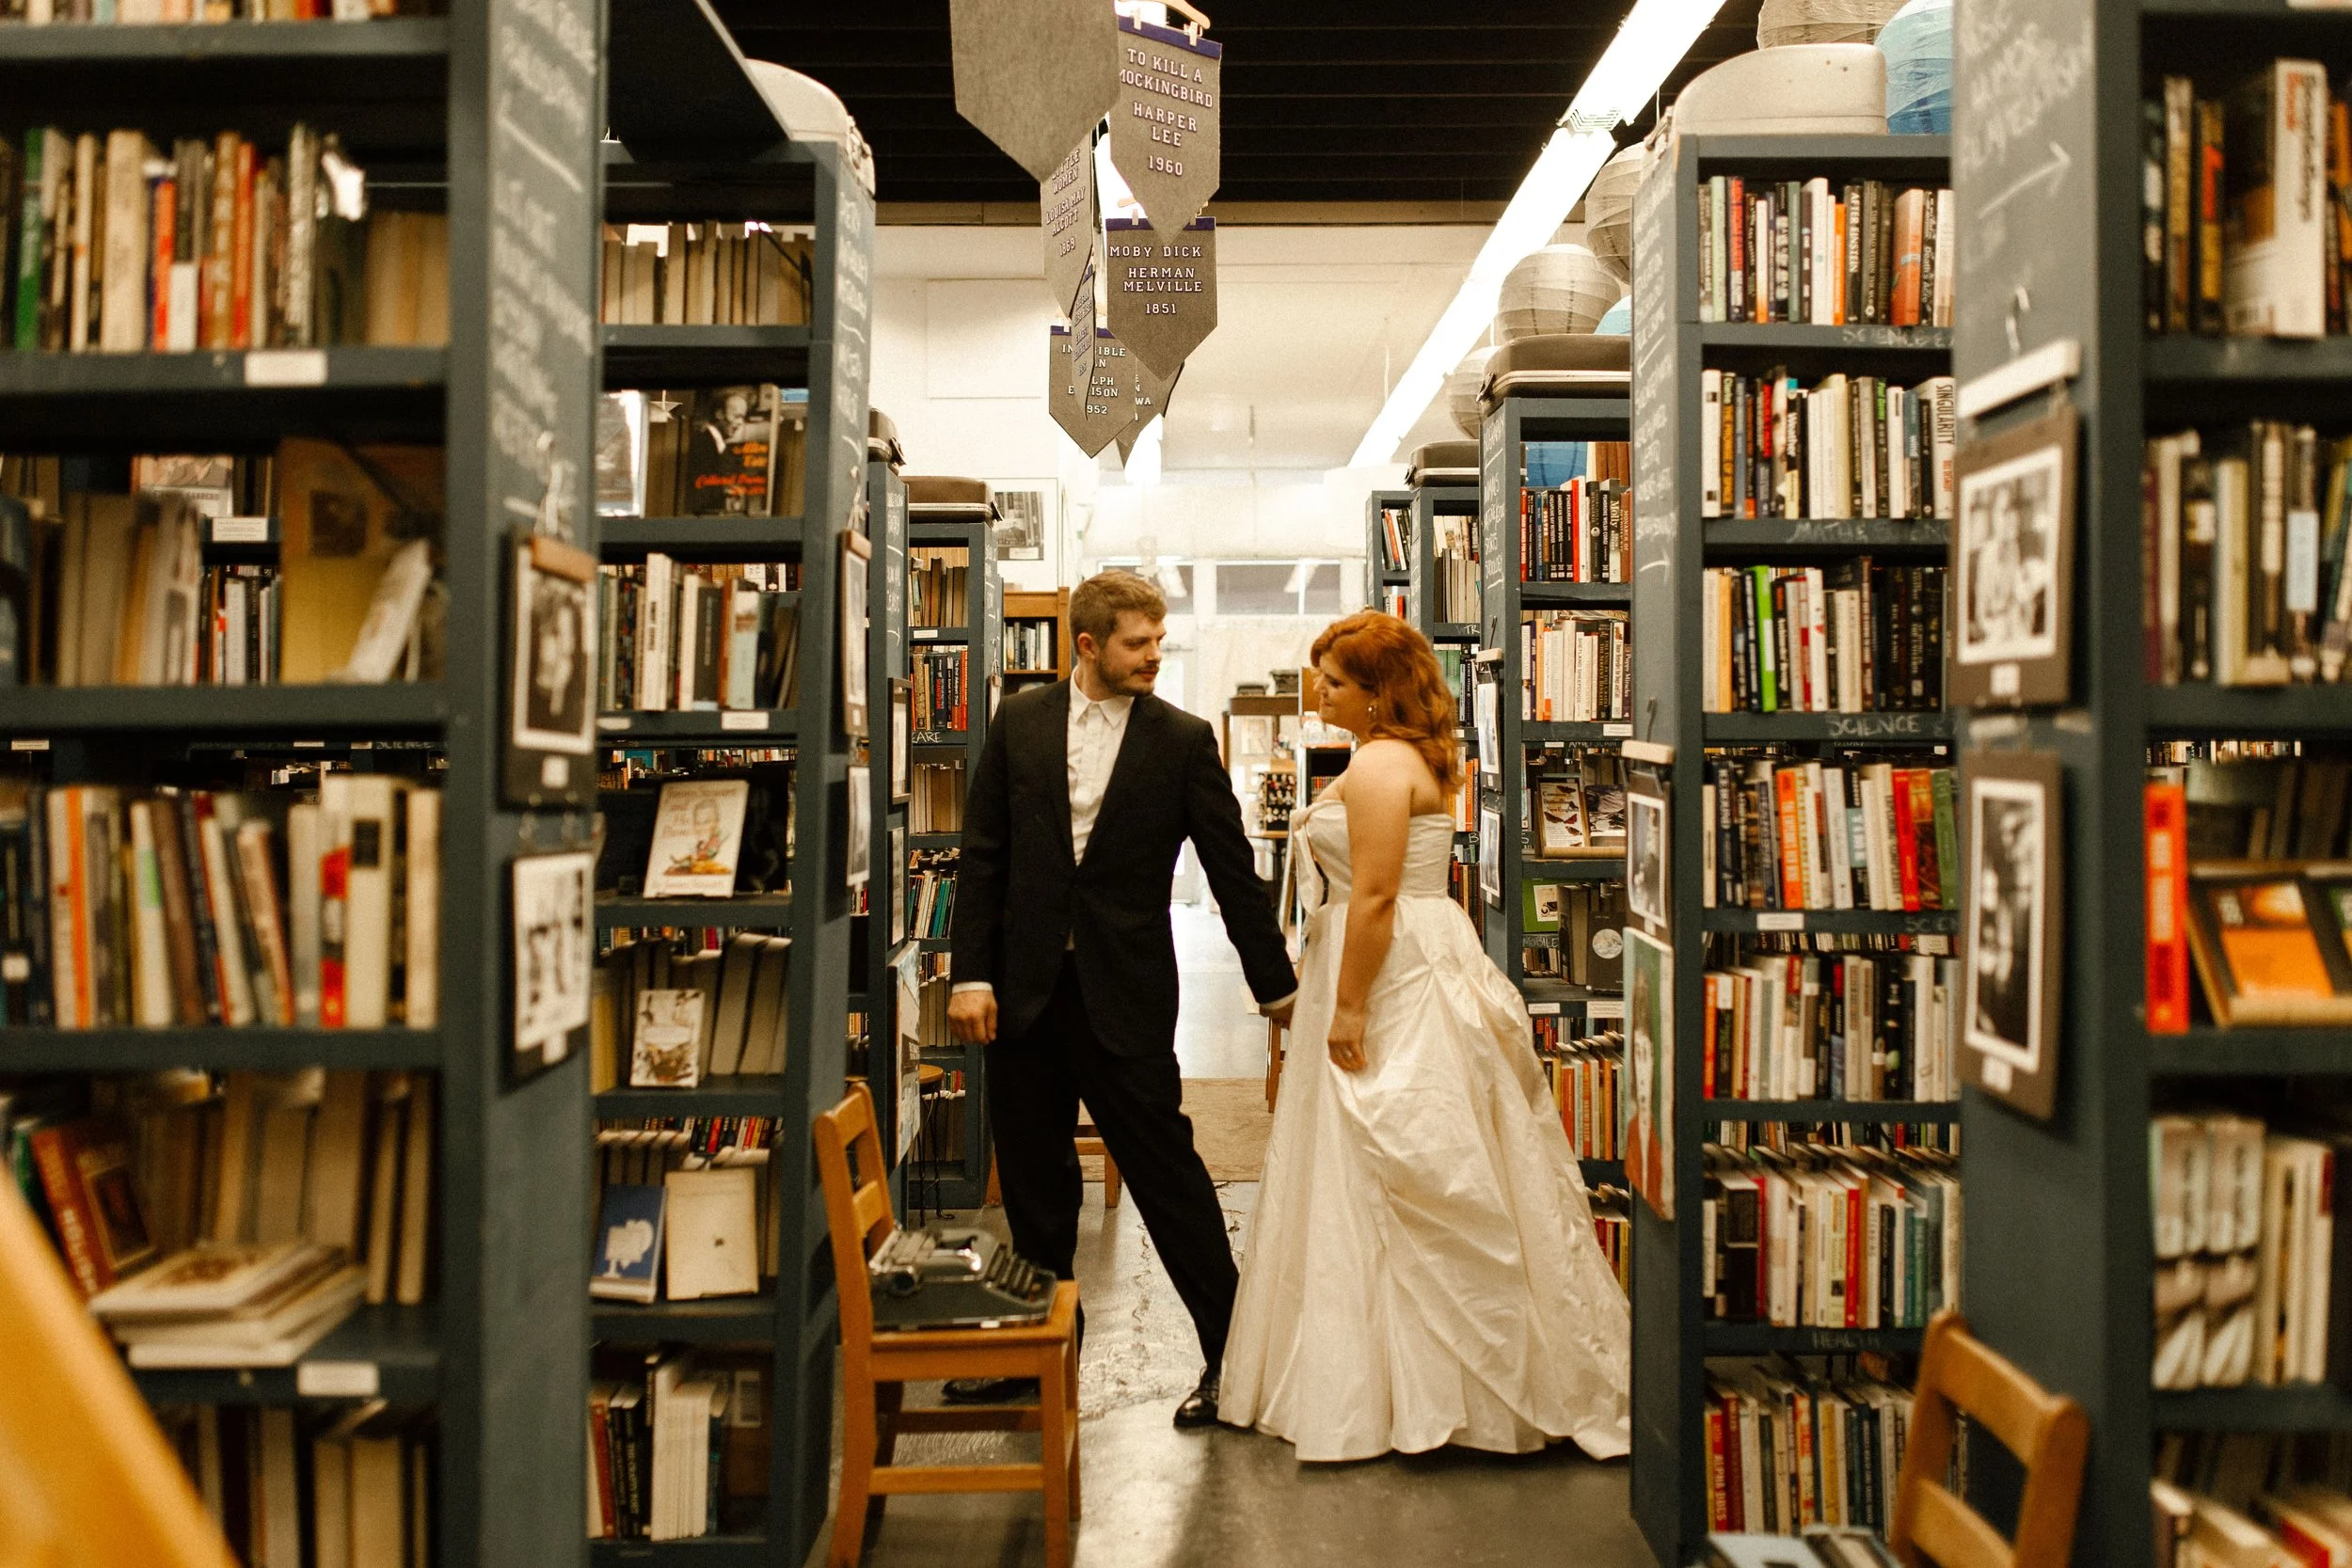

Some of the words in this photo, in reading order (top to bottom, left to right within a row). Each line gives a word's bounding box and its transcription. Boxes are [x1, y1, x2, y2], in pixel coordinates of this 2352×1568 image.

[1127, 48, 1146, 66] TO
[1152, 56, 1188, 78] KILL
[1193, 68, 1202, 83] A
[1133, 102, 1198, 132] HARPER
[1152, 125, 1183, 147] LEE
[1149, 155, 1184, 177] 1960
[1053, 166, 1079, 194] WOMEN
[1046, 198, 1070, 225] LOUISA
[1071, 186, 1086, 208] MAY
[1851, 193, 1860, 224] AFTER
[1052, 209, 1078, 236] ALCOTT
[1110, 246, 1152, 257] MOBY
[1164, 245, 1202, 257] DICK
[1849, 226, 1859, 273] EINSTEIN
[1923, 246, 1931, 279] Death's
[1129, 267, 1195, 278] HERMAN
[1123, 280, 1203, 293] MELVILLE
[1145, 303, 1177, 314] 1851
[1087, 404, 1107, 415] 952
[1936, 385, 1954, 445] SINGULARITY
[1610, 500, 1619, 528] Molly
[1826, 715, 1920, 736] SCIENCE
